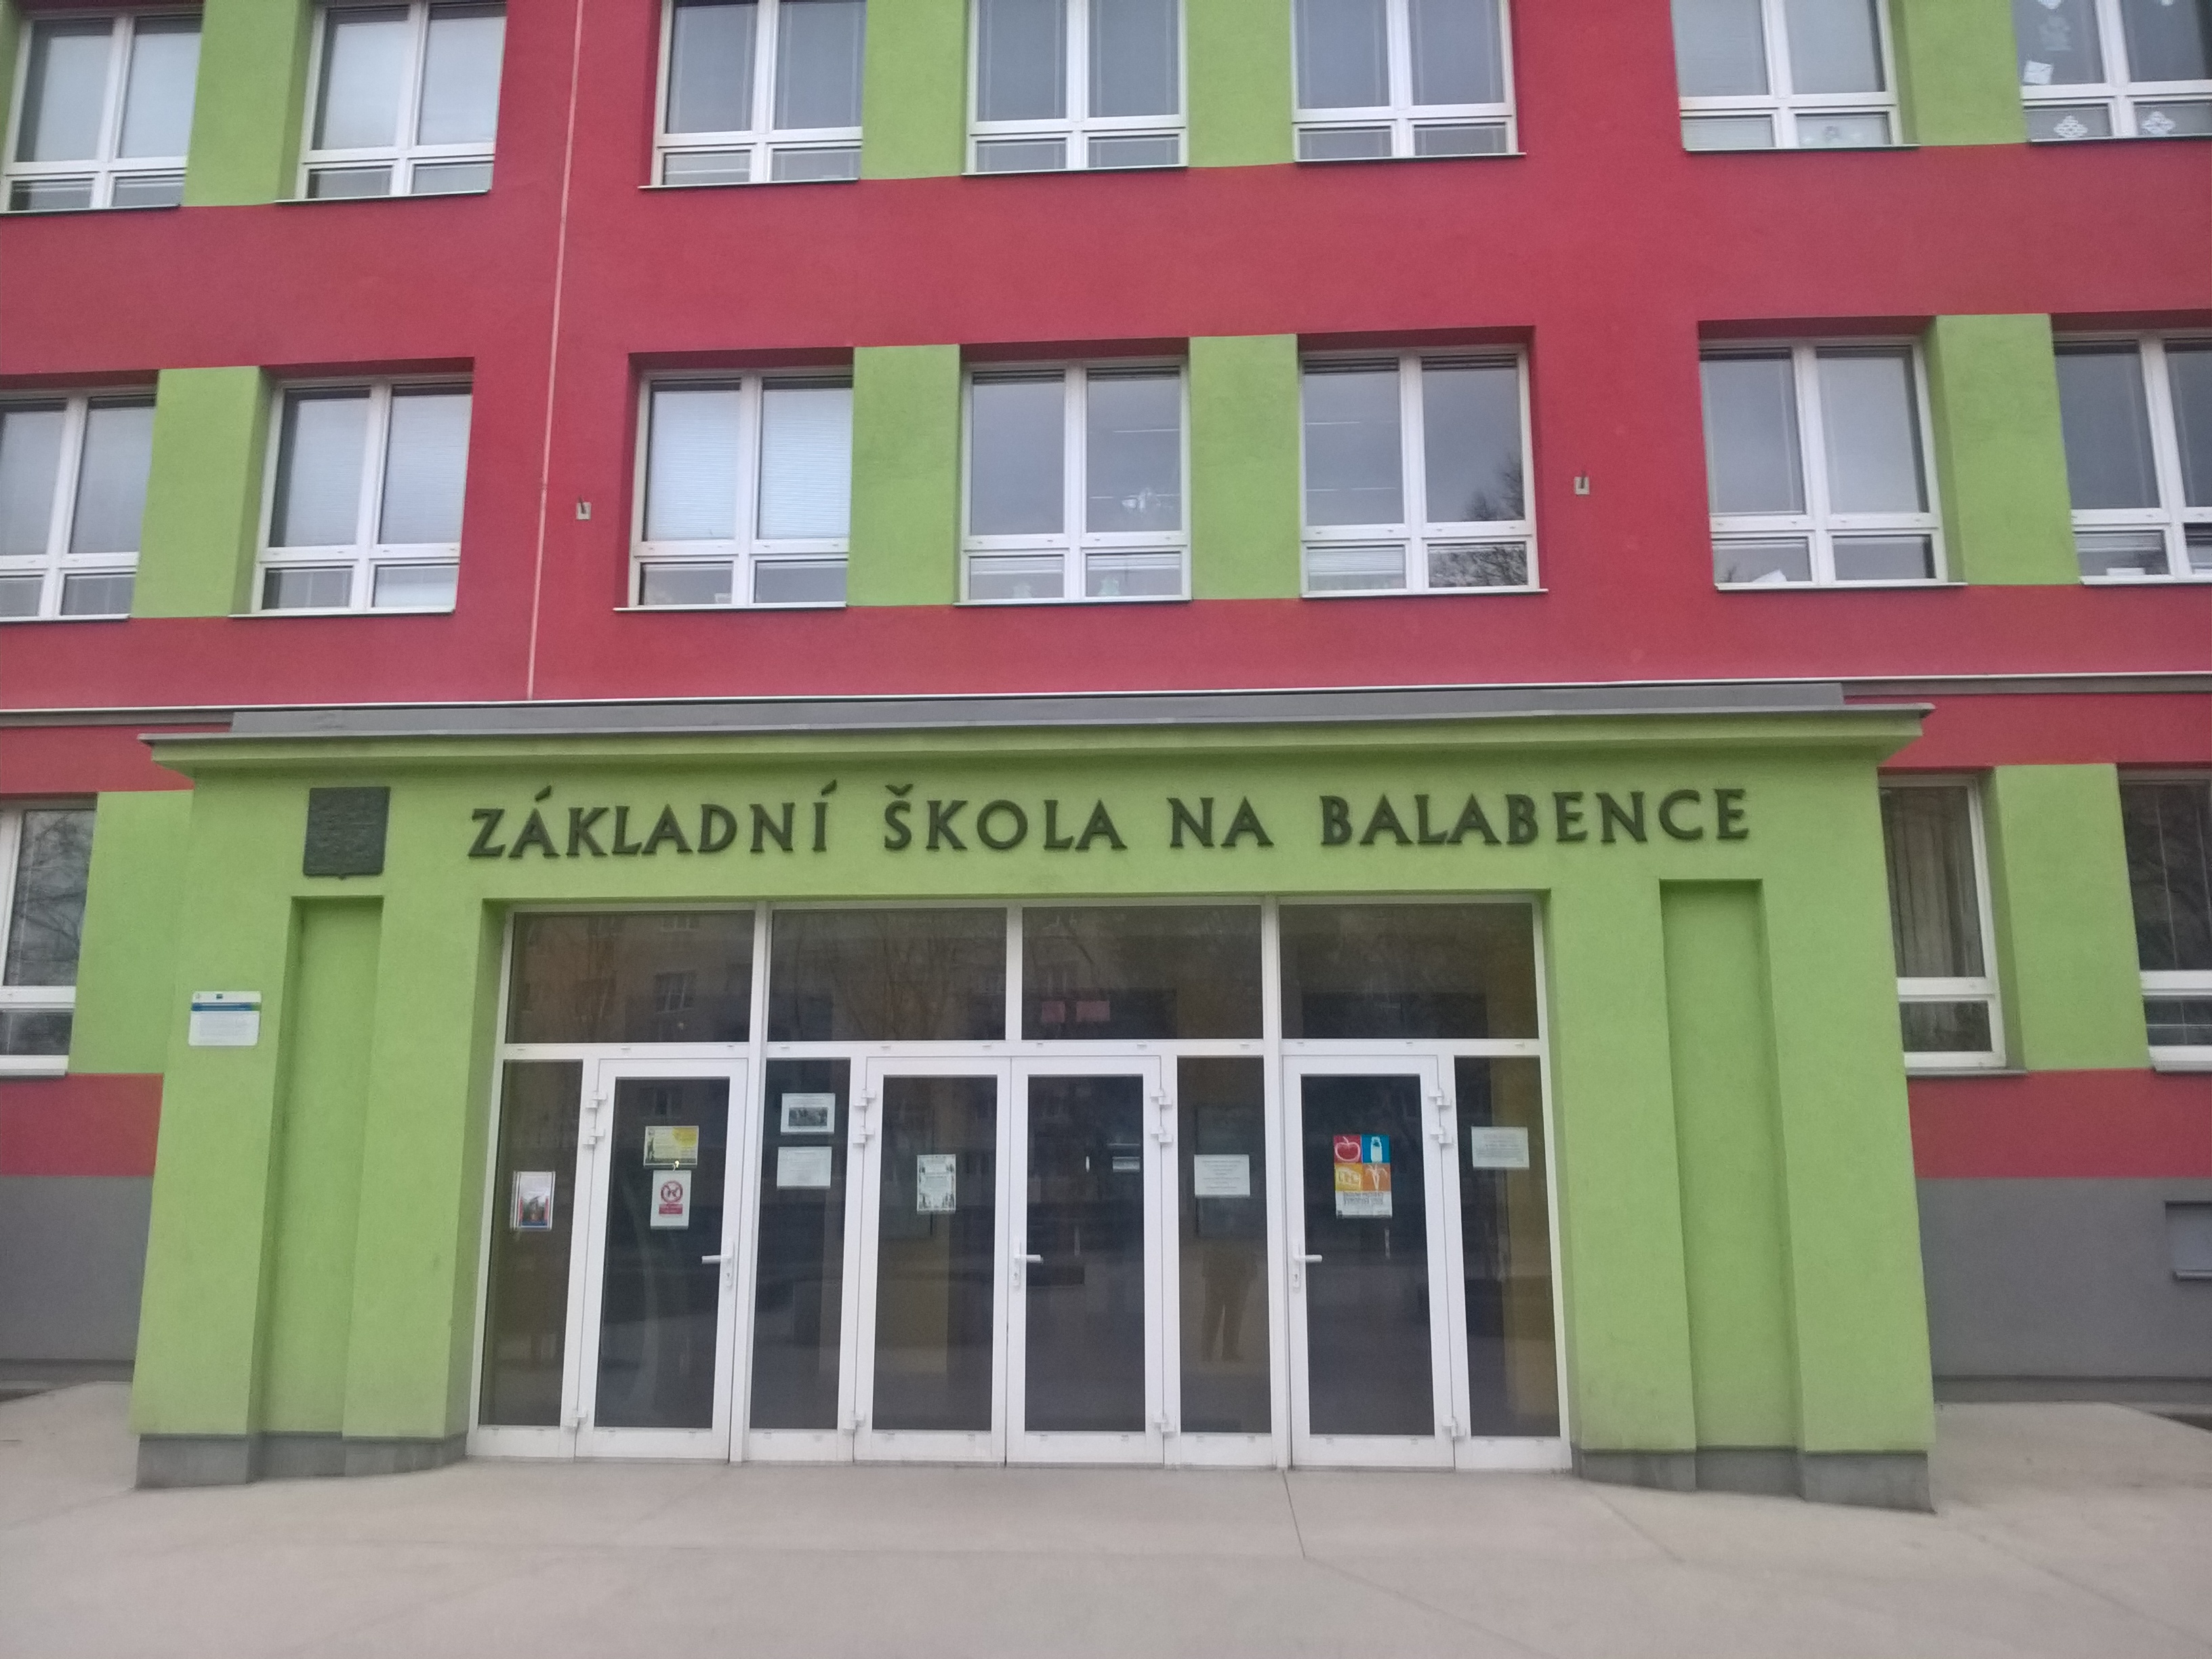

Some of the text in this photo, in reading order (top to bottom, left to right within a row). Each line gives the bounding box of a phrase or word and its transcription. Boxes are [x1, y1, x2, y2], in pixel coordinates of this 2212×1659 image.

[468, 779, 1750, 858] ZÁKLADNÍ ŠKOLA NA BALABENCE
